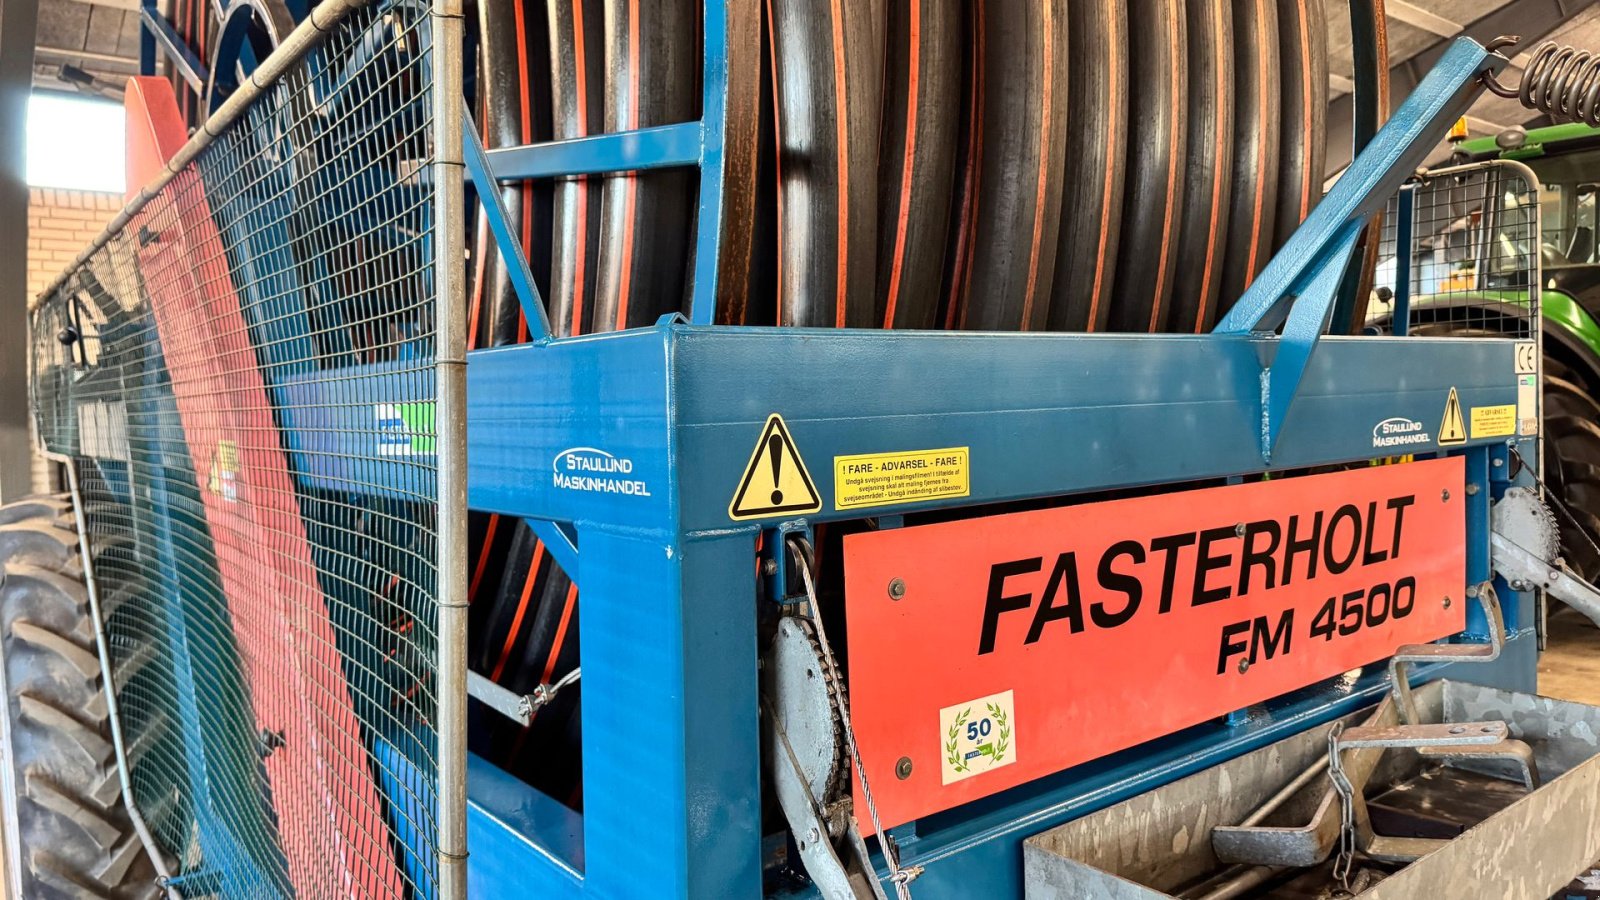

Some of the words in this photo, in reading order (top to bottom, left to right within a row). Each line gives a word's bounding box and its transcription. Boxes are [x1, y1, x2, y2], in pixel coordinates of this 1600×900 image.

[1518, 345, 1533, 371] CE
[1382, 421, 1422, 434] STAULUND
[1373, 433, 1431, 448] MASKINHANDEL
[566, 454, 633, 473] STAULUND
[848, 463, 873, 474] FARE
[881, 459, 928, 471] ADVARSEL
[935, 456, 958, 467] FARE
[553, 472, 651, 497] MASKINHANDEL
[978, 495, 1416, 656] FASTERHOLT
[1216, 608, 1295, 675] FM
[1309, 575, 1417, 643] 4500
[966, 717, 992, 741] 50
